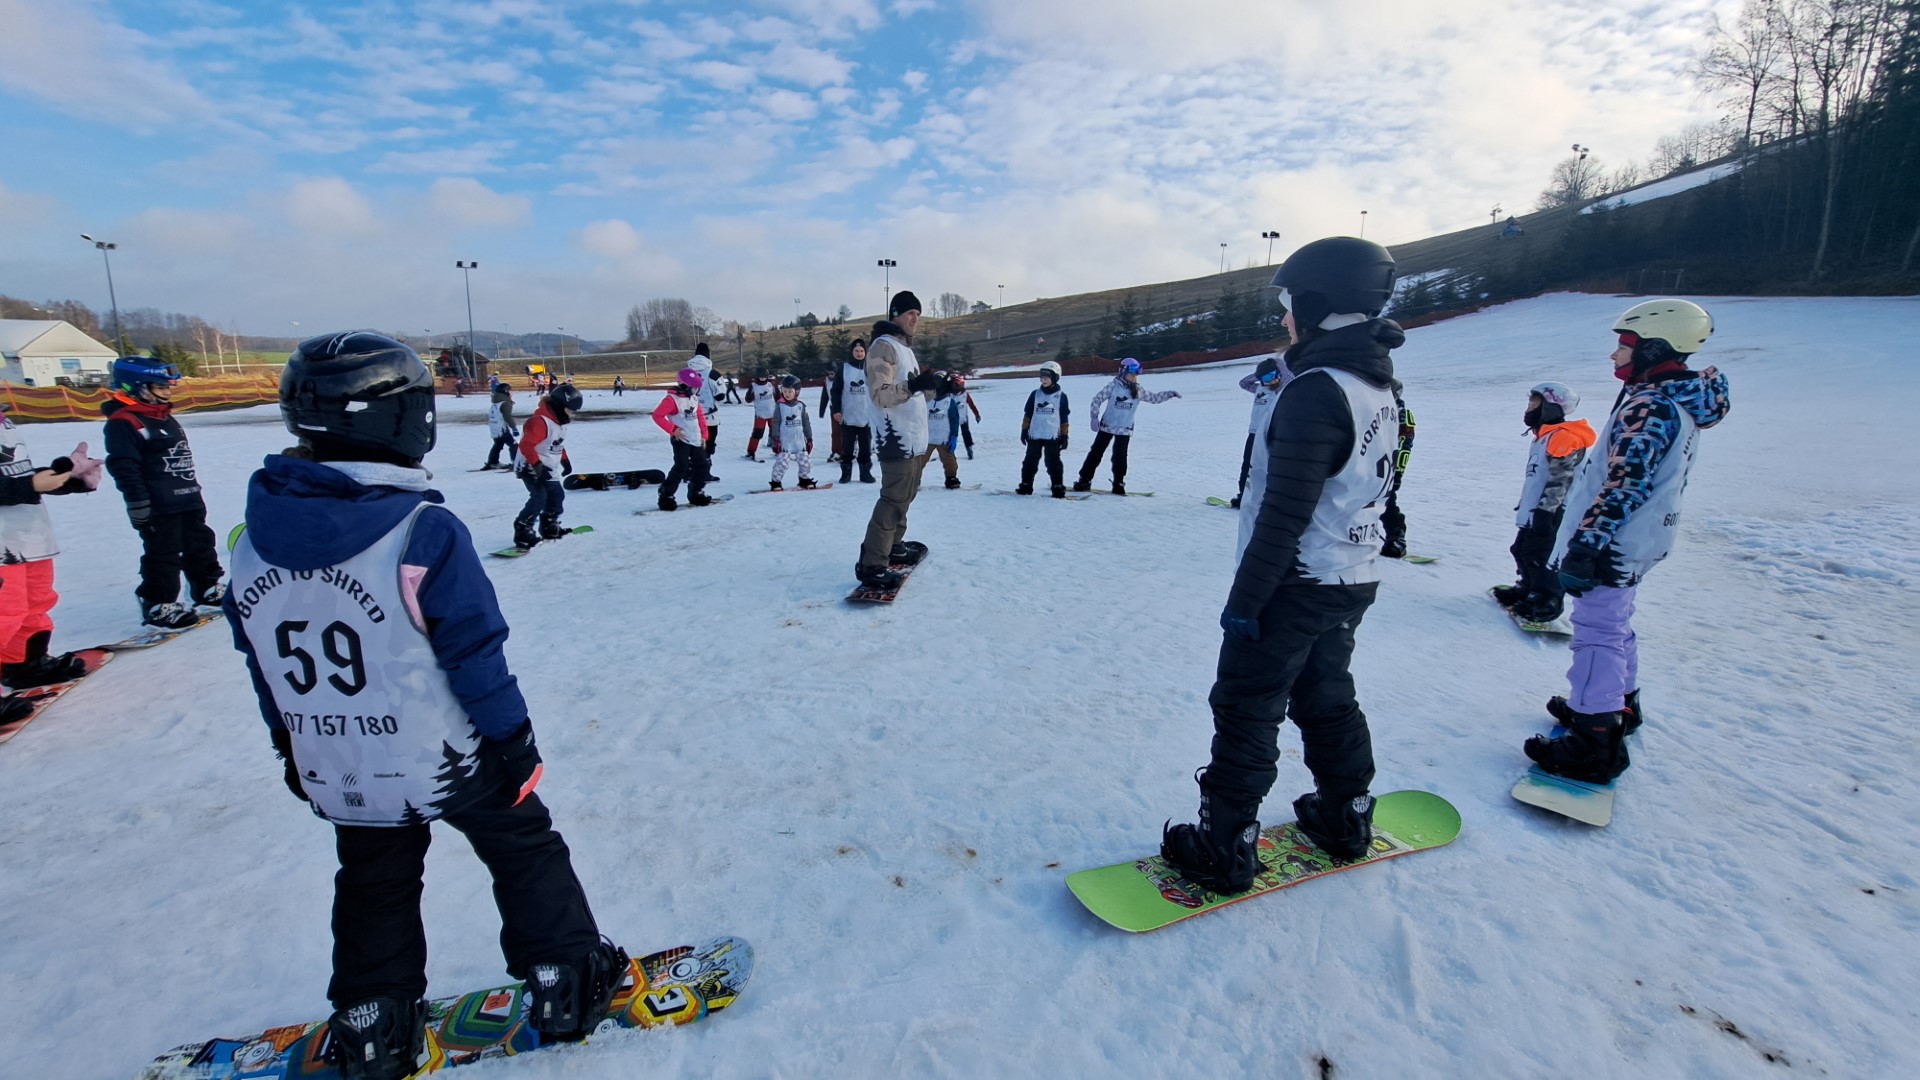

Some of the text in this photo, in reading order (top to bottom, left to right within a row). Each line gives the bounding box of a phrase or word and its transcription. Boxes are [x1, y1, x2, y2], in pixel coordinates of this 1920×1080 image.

[237, 568, 283, 620] BORN
[320, 565, 386, 624] SHRED
[275, 620, 367, 696] 59
[282, 711, 398, 736] 07 157 180
[348, 1002, 379, 1017] SALO
